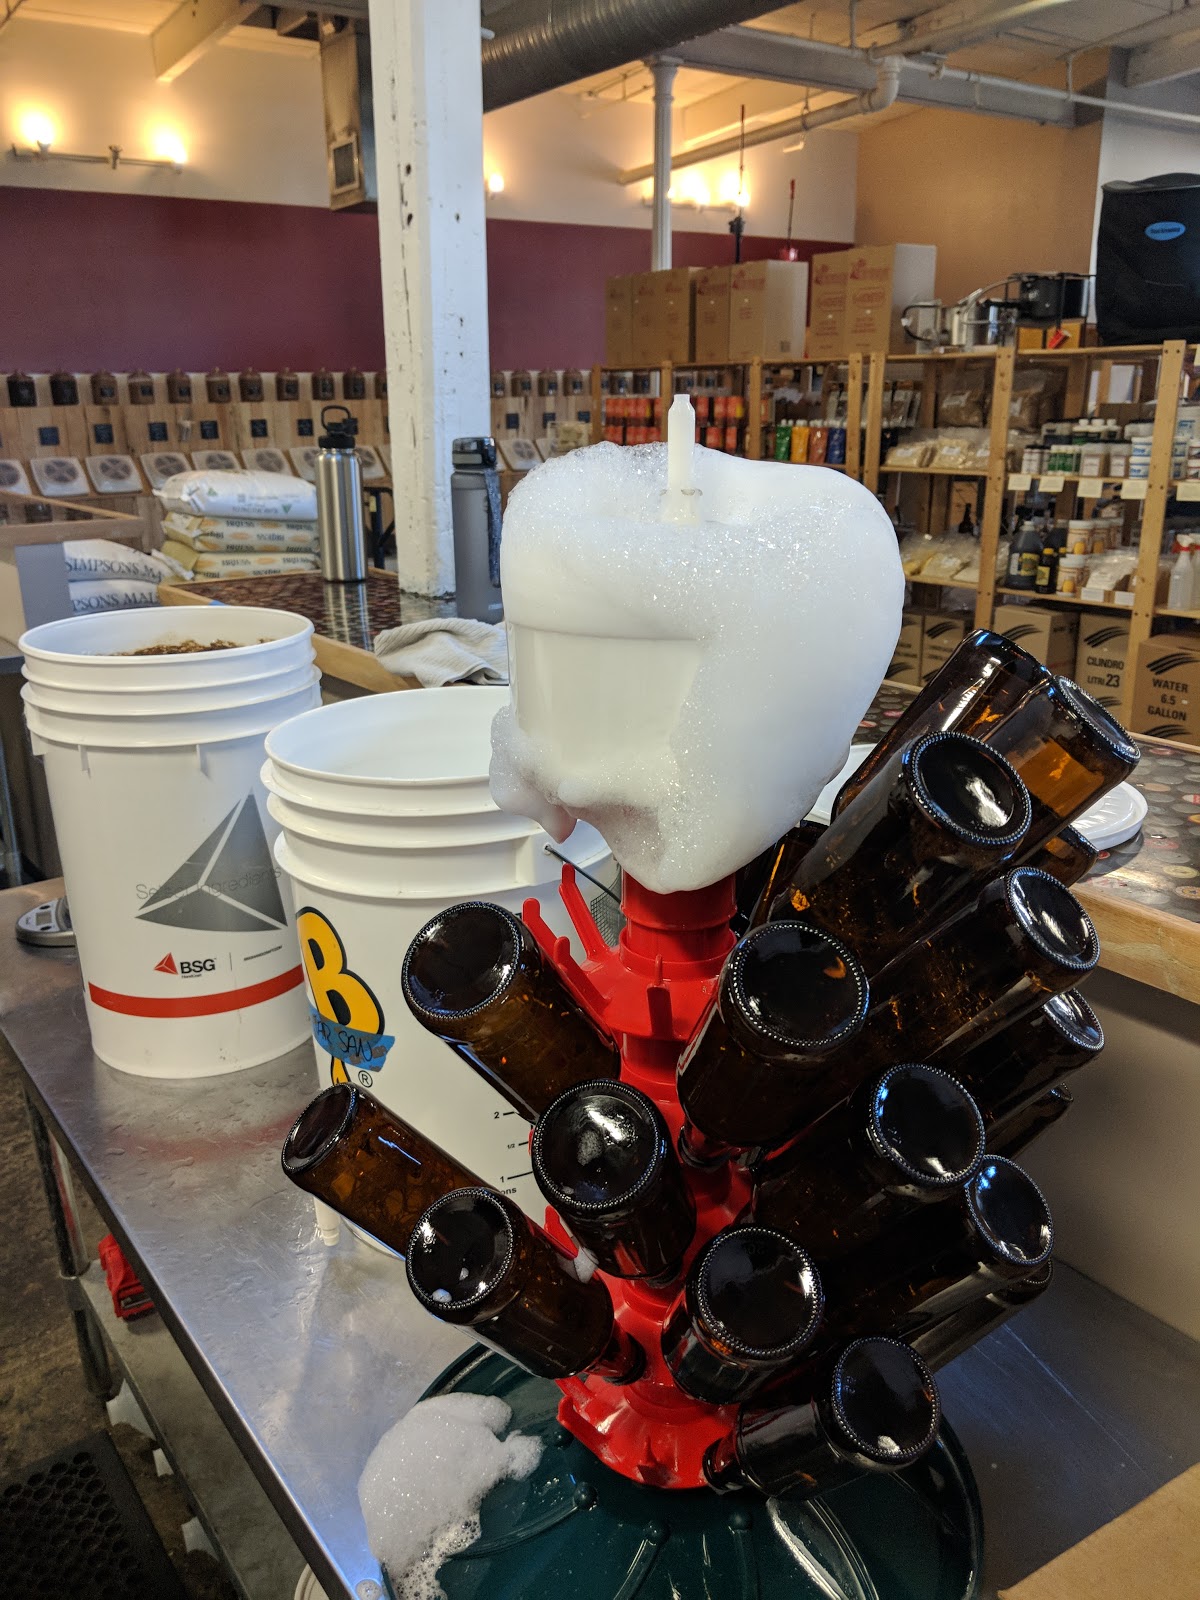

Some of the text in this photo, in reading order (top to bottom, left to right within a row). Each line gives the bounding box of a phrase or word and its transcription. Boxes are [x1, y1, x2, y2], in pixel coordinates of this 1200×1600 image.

[64, 558, 139, 576] SIMPSONS
[1086, 656, 1125, 671] CILINDRO
[1105, 673, 1120, 688] 23
[1151, 678, 1189, 693] WATER
[1160, 693, 1177, 706] 6.5
[1147, 705, 1188, 721] GALLON
[179, 959, 216, 975] BSG
